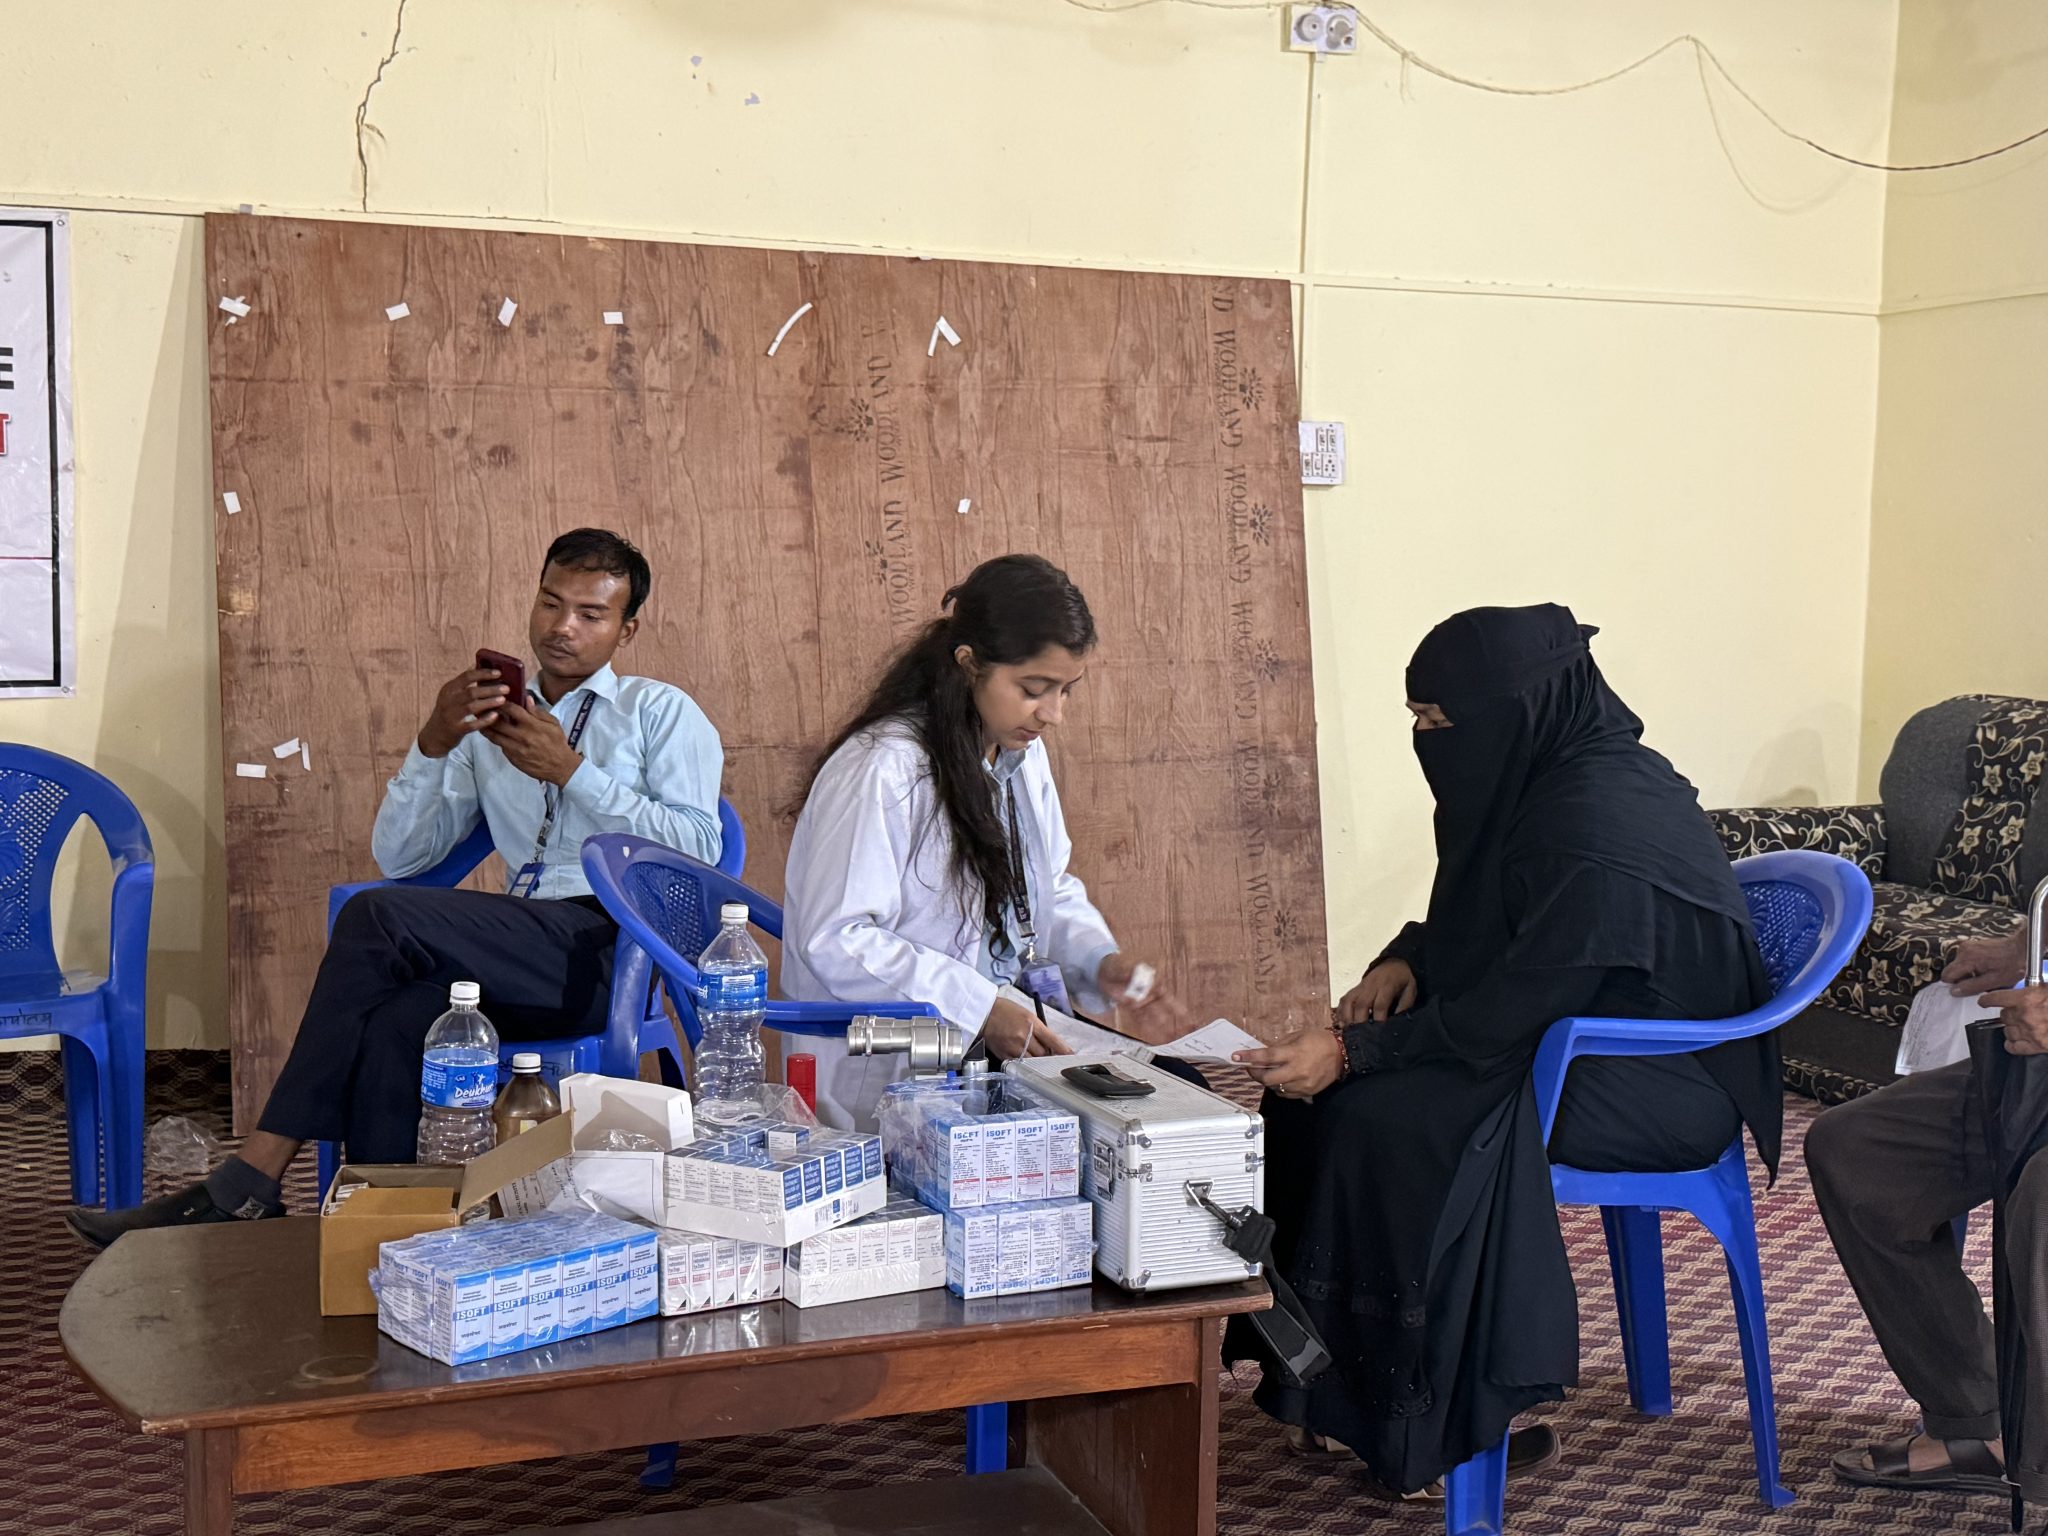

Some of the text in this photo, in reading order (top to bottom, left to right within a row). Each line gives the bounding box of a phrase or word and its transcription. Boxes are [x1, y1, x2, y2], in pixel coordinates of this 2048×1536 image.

[1213, 330, 1243, 447] WOODLAND
[867, 355, 905, 484] WOODLAND
[1224, 464, 1251, 583] WOODLAND
[884, 500, 916, 626] WOODLAND
[1231, 601, 1257, 719] WOOAND
[1018, 1126, 1043, 1135] ISOFT
[1050, 1122, 1075, 1131] ISOFT
[986, 1129, 1012, 1138] ISOFT
[412, 1268, 428, 1281] ISOFT
[631, 1264, 655, 1278] ISOFT
[435, 1277, 452, 1290] ISOFT
[597, 1274, 623, 1288] ISOFT
[563, 1282, 590, 1296] ISOFT
[529, 1291, 556, 1304] ISOFT
[494, 1299, 521, 1312] ISOFT
[457, 1307, 487, 1320] ISOFT
